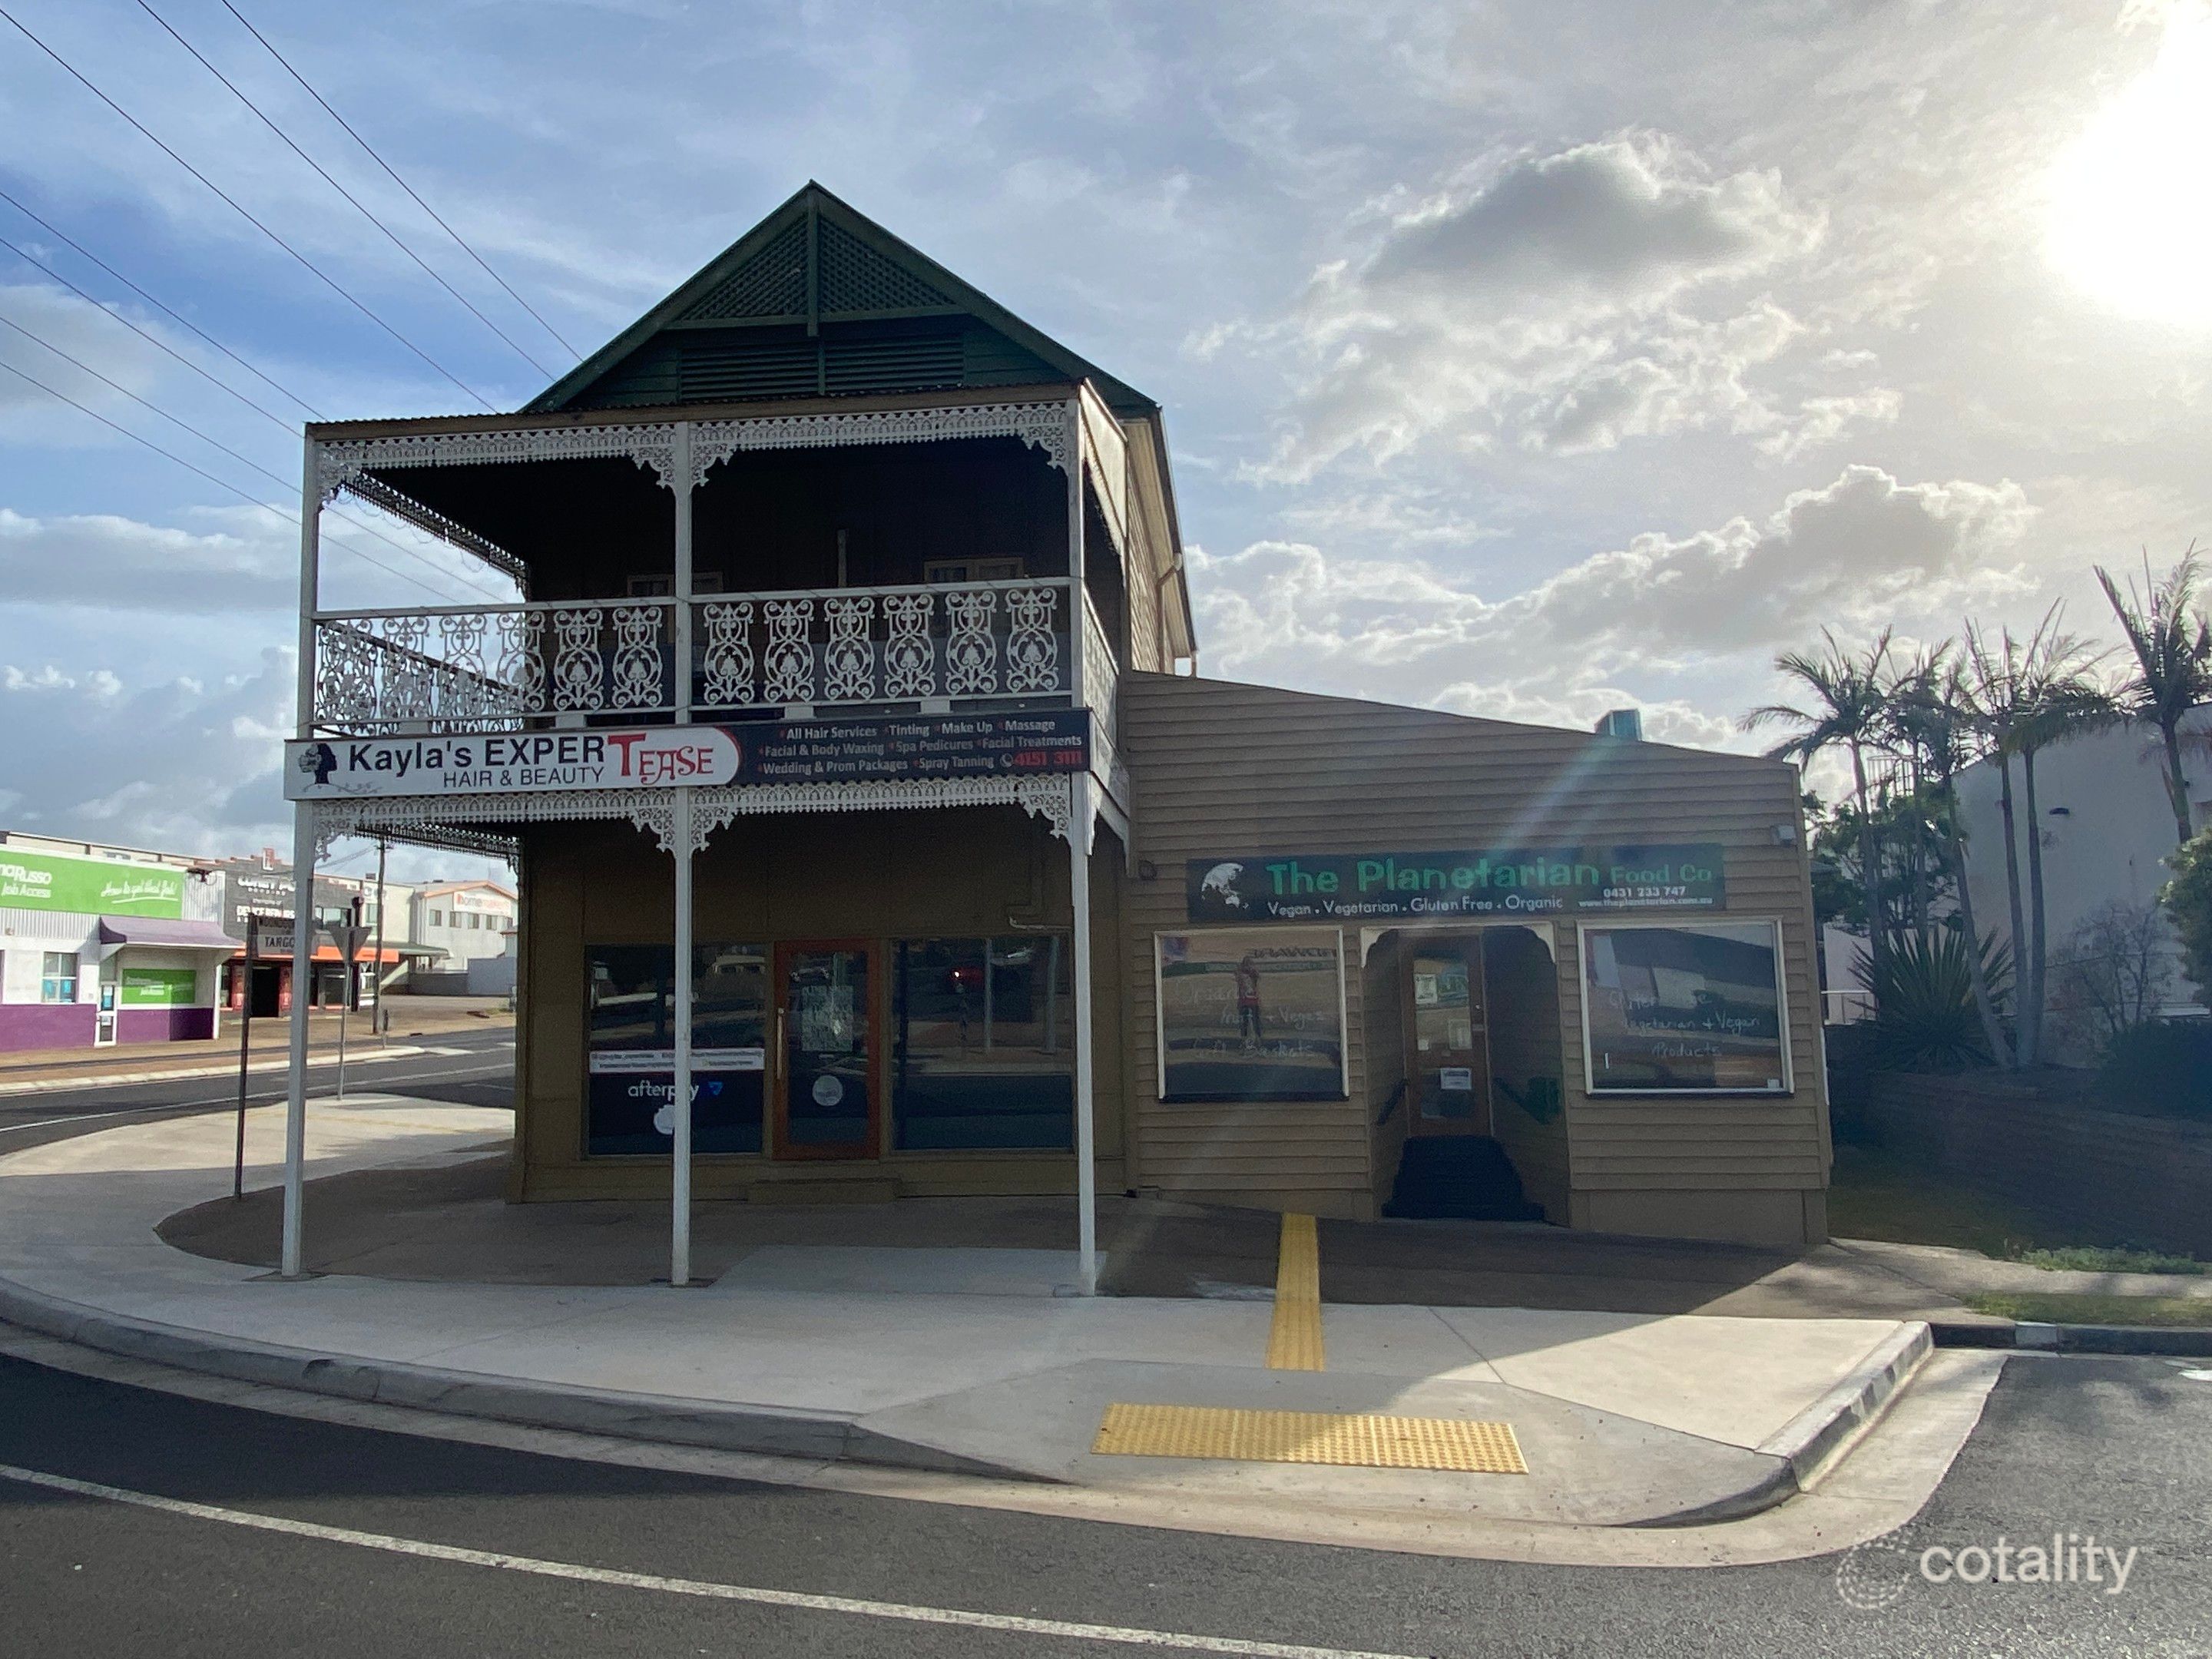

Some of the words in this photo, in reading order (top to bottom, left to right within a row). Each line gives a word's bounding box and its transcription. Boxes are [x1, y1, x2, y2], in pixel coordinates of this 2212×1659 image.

[786, 727, 801, 740] All
[804, 727, 828, 739] Hair
[831, 726, 877, 738] Services
[889, 724, 929, 737] Tinting
[942, 722, 973, 734] Make
[977, 720, 992, 733] Up
[1005, 720, 1055, 732] Massage
[765, 744, 796, 757] Facial
[800, 744, 809, 756] &
[812, 744, 840, 757] Body
[843, 743, 884, 756] Waxing
[896, 741, 916, 754] Spa
[919, 739, 973, 752] Pedicures
[982, 736, 1014, 749] Facial
[1018, 735, 1082, 747] Treatments
[349, 740, 472, 777] Kayla's
[763, 762, 811, 776] Wedding
[814, 760, 823, 773] &
[826, 760, 855, 773] Prom
[859, 759, 908, 773] Packages
[919, 757, 949, 770] Spray
[952, 755, 994, 769] Tanning
[1015, 751, 1047, 766] 4151
[443, 770, 492, 788] HAIR
[500, 770, 512, 785] &
[520, 767, 604, 785] BEAUTY
[1266, 860, 1339, 895] The
[1356, 856, 1599, 892] Planetarian
[1610, 864, 1670, 885] Food
[1679, 863, 1712, 882] Co
[1603, 887, 1632, 898] 0431
[1637, 886, 1660, 897] 233
[1664, 885, 1686, 896] 747
[1267, 901, 1311, 918] Vegan
[1322, 899, 1398, 916] Vegetarian
[1411, 897, 1459, 912] Gluten
[1462, 896, 1492, 910] Free
[1505, 894, 1563, 912] Organic
[628, 1080, 699, 1101] afterpy
